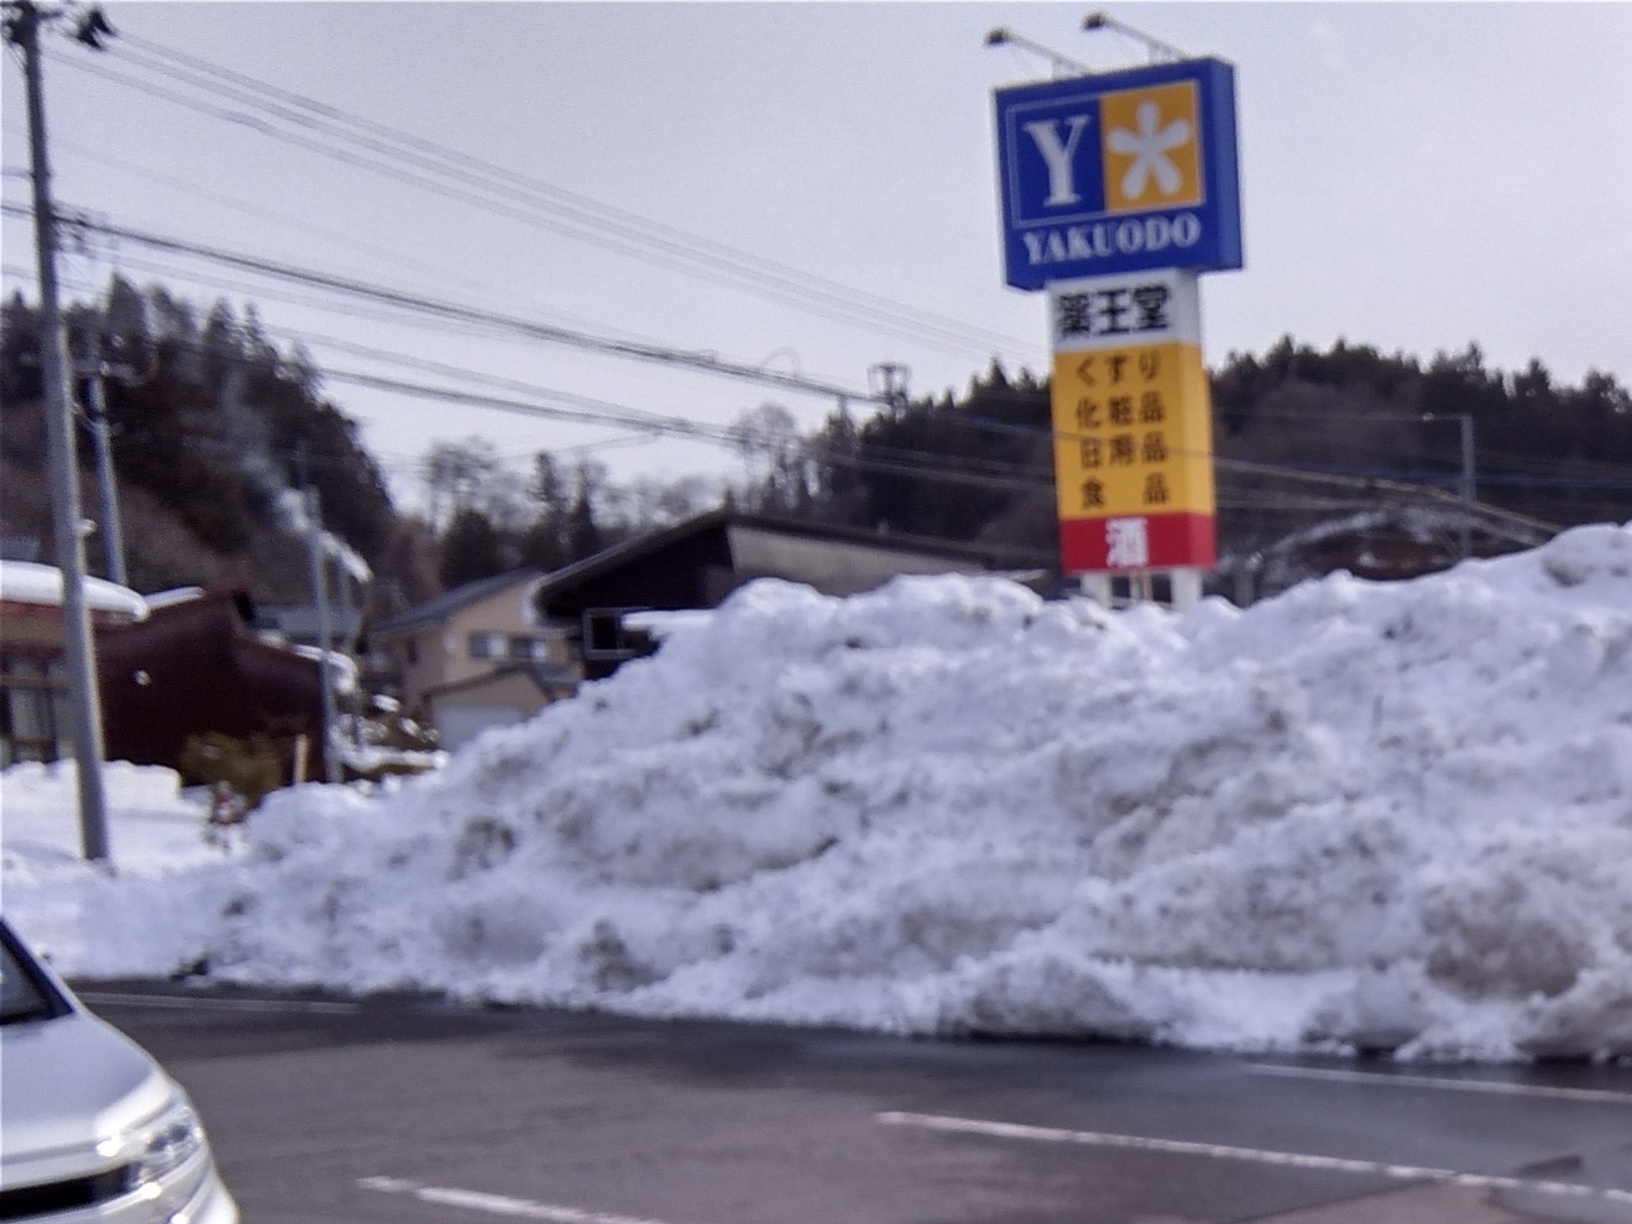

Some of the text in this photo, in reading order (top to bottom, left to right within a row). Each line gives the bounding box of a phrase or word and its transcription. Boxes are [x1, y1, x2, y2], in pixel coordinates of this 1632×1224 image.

[1021, 114, 1092, 207] Y
[1022, 213, 1200, 266] YAKUODO
[1057, 285, 1168, 337] 薬王堂
[1076, 350, 1160, 387] くすり
[1075, 390, 1166, 430] 化粧品
[1105, 516, 1149, 568] 酒
